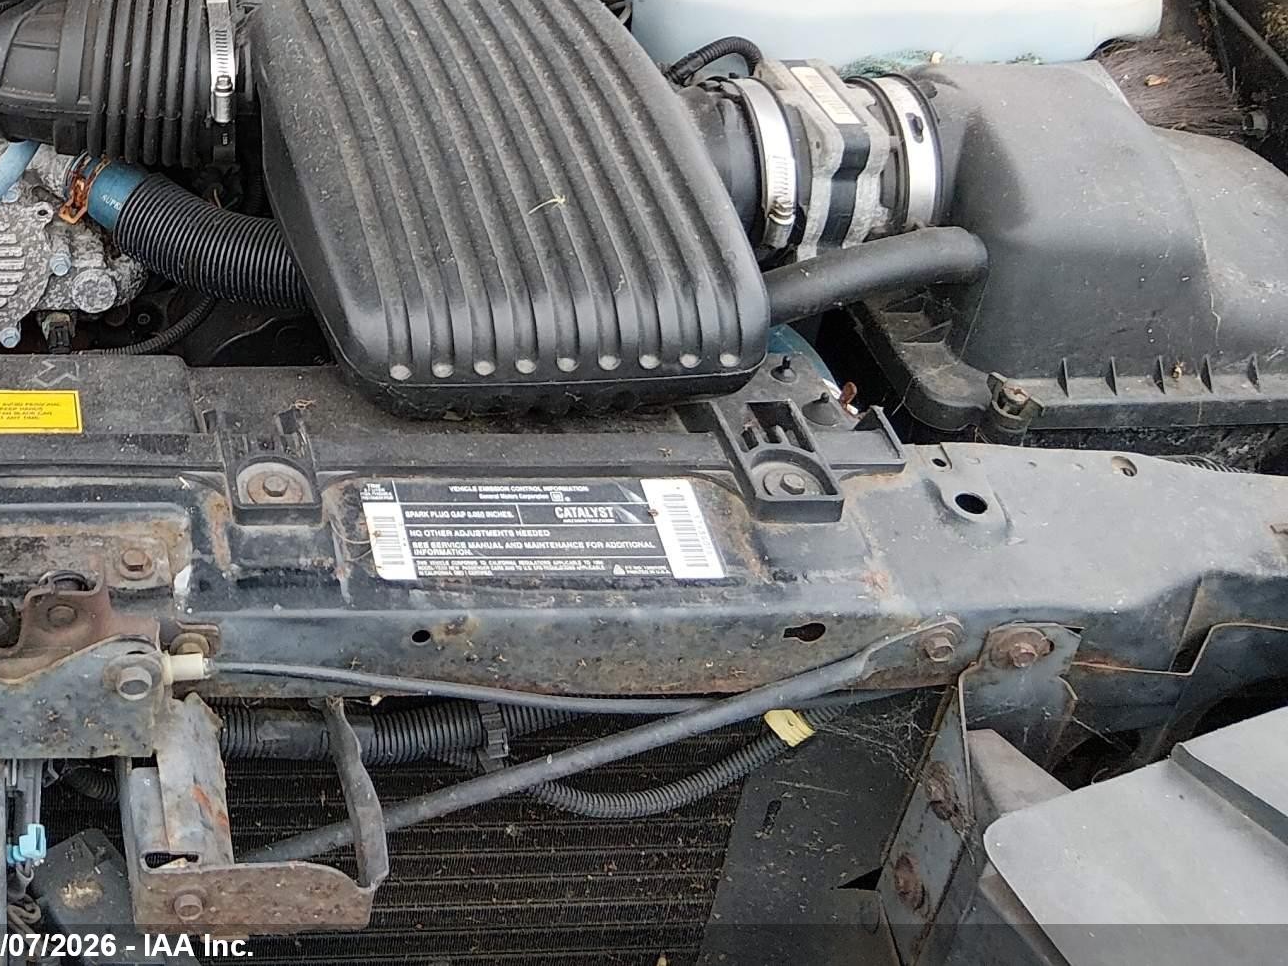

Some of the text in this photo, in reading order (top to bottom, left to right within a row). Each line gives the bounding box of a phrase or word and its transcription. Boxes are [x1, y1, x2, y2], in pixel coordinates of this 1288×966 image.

[404, 510, 430, 518] SPARK
[430, 510, 450, 518] PLUG
[450, 510, 466, 518] GAP
[554, 506, 614, 519] CATALYST
[413, 548, 474, 556] INFORMATION.
